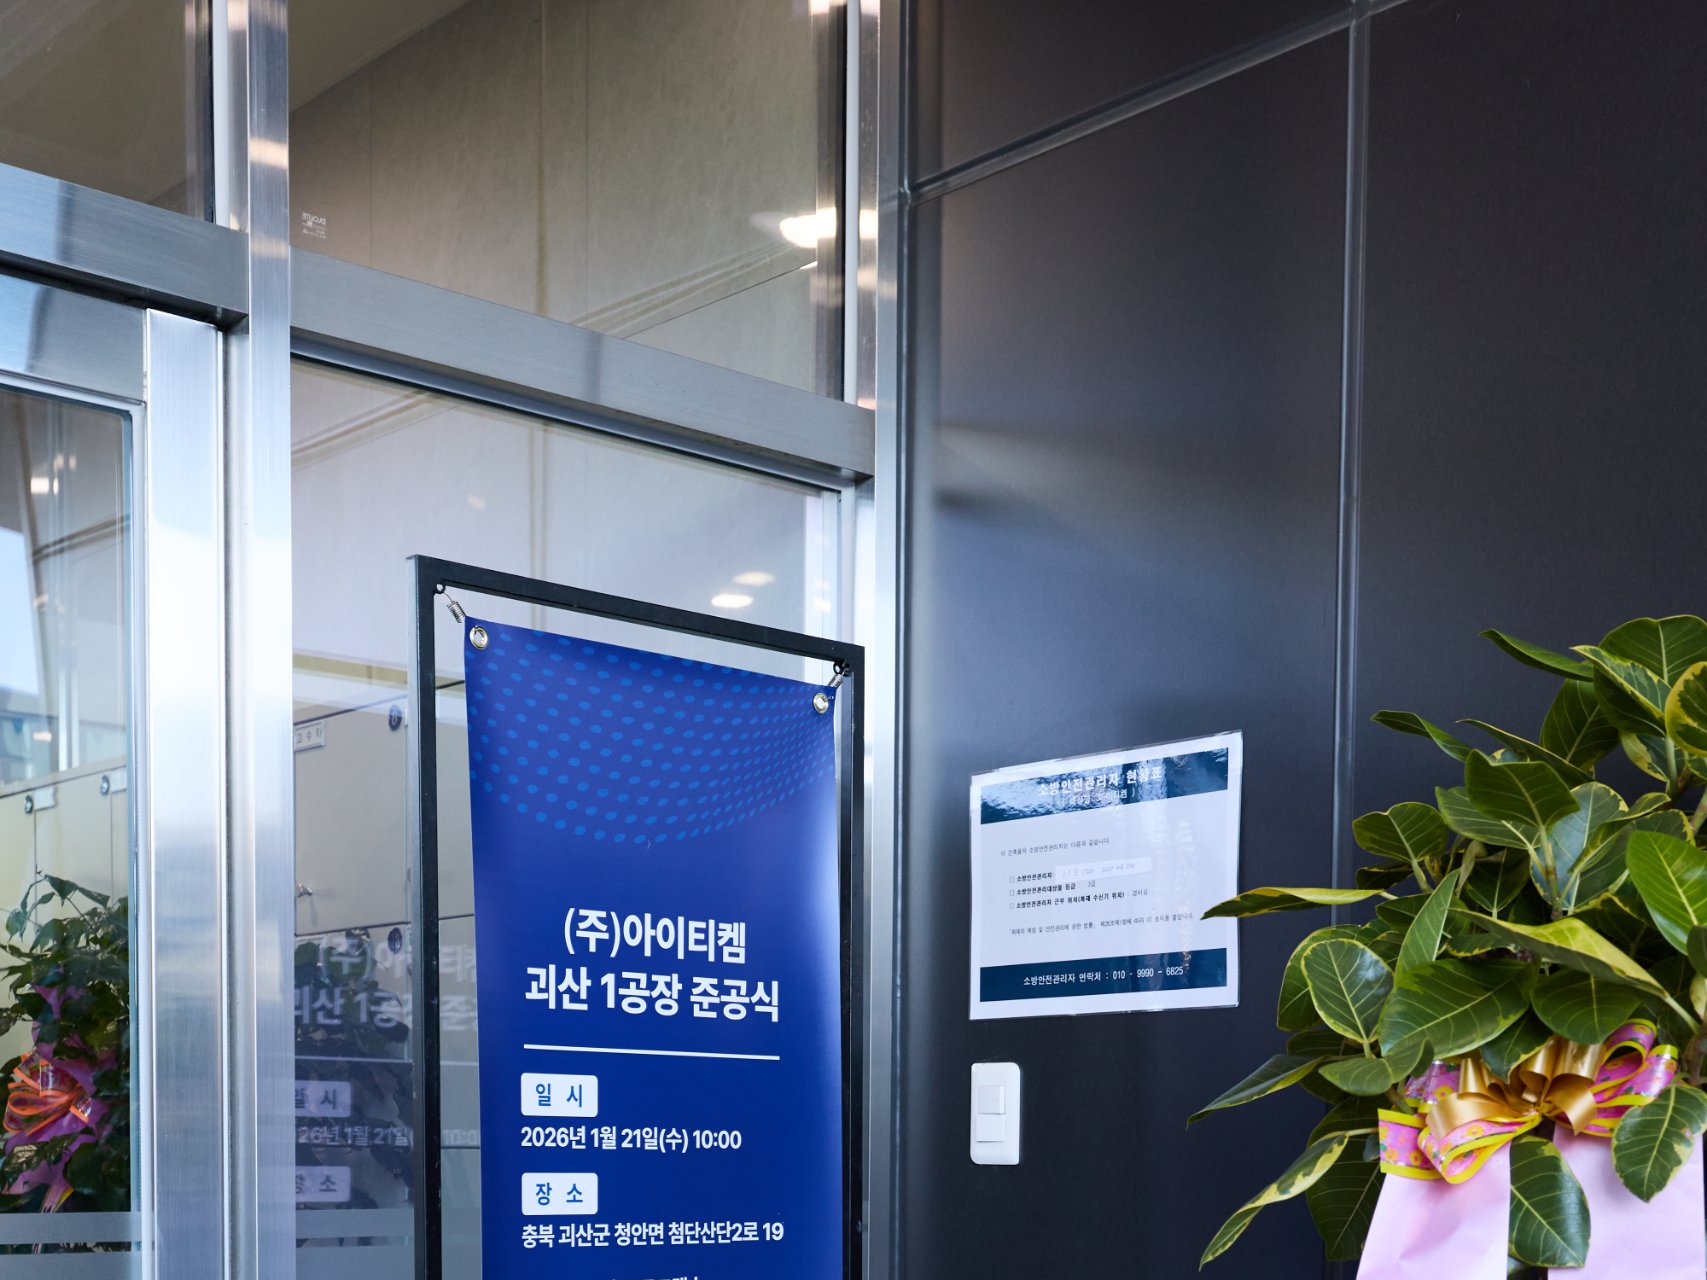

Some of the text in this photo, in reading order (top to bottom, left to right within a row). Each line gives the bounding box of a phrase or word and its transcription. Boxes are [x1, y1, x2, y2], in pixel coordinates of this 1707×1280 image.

[1038, 775, 1120, 797] 소방안전관리자
[565, 908, 745, 963] (주)아이티켐
[1023, 973, 1075, 987] 소방안전관리자
[1079, 971, 1101, 982] 연락처
[1166, 966, 1184, 976] 6825
[525, 964, 591, 1010] 괴산
[601, 972, 682, 1016] 1공장
[690, 977, 778, 1022] 준공식
[536, 1084, 582, 1107] 일 시
[521, 1126, 741, 1153] 2026년 1월 21일(수) 10:00
[536, 1183, 583, 1205] 장 소
[522, 1221, 784, 1248] 충북 괴산군 청안면 첨단산단2로 19
